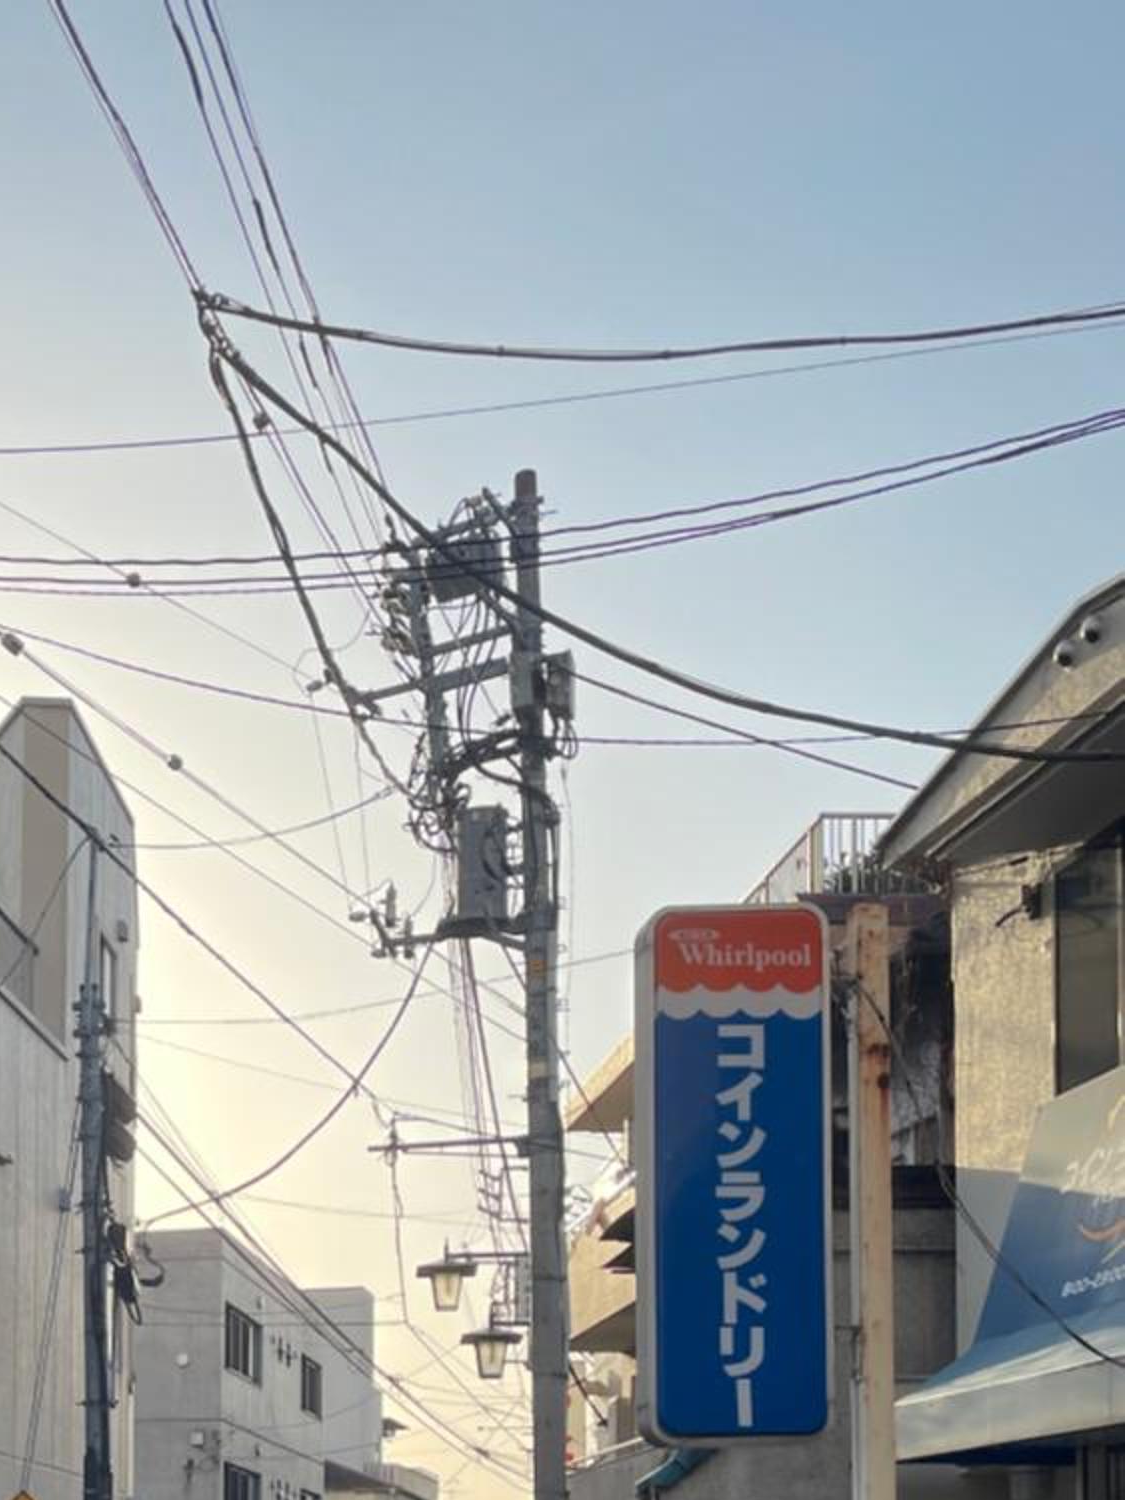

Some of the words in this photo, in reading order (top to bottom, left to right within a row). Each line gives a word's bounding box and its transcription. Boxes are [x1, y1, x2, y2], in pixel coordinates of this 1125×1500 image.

[679, 942, 812, 972] Whirlpool
[715, 1023, 768, 1428] コインランドリー
